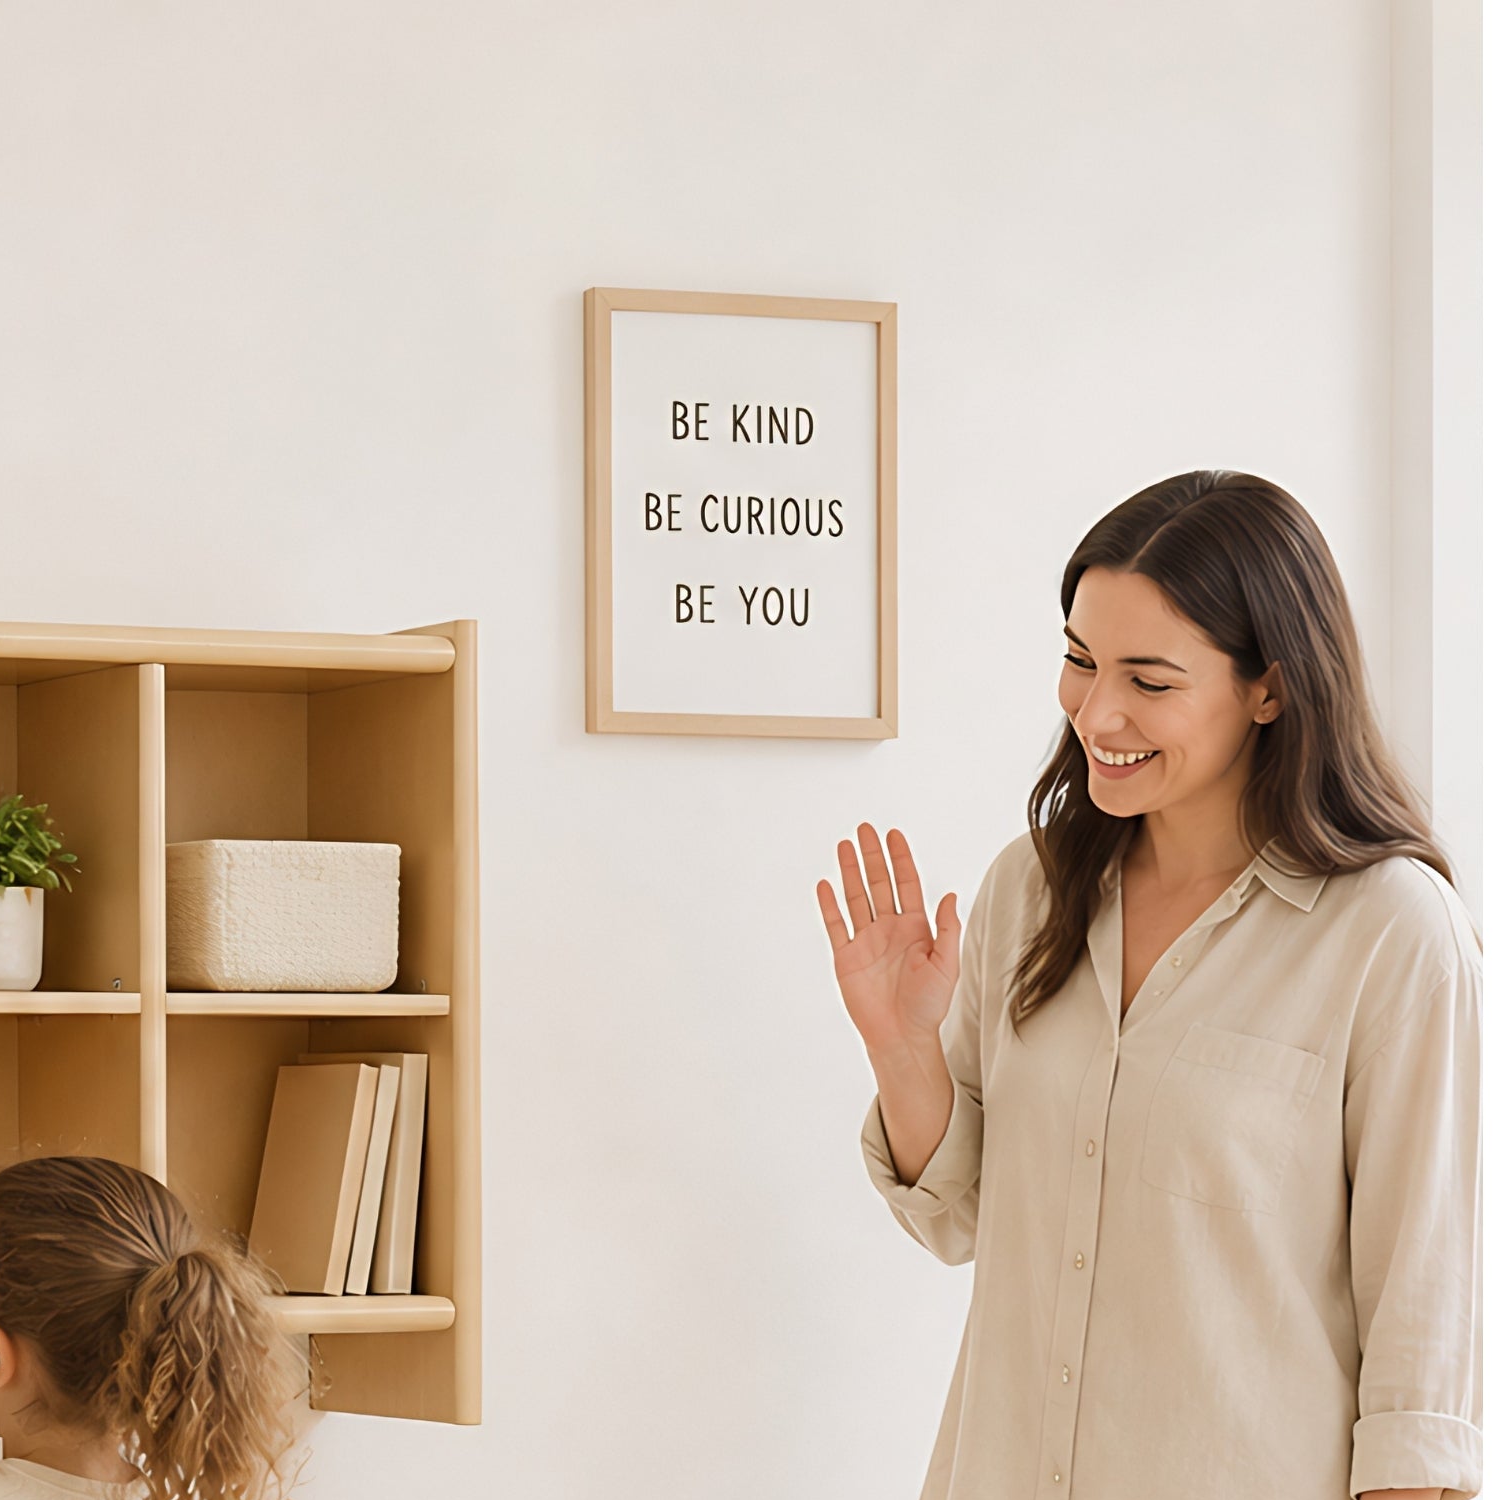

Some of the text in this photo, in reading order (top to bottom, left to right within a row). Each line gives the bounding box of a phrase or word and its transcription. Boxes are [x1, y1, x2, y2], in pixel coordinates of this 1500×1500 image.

[672, 400, 814, 446] BE KIND
[644, 492, 844, 538] BE CURIOUS
[675, 583, 809, 627] BE YOU
